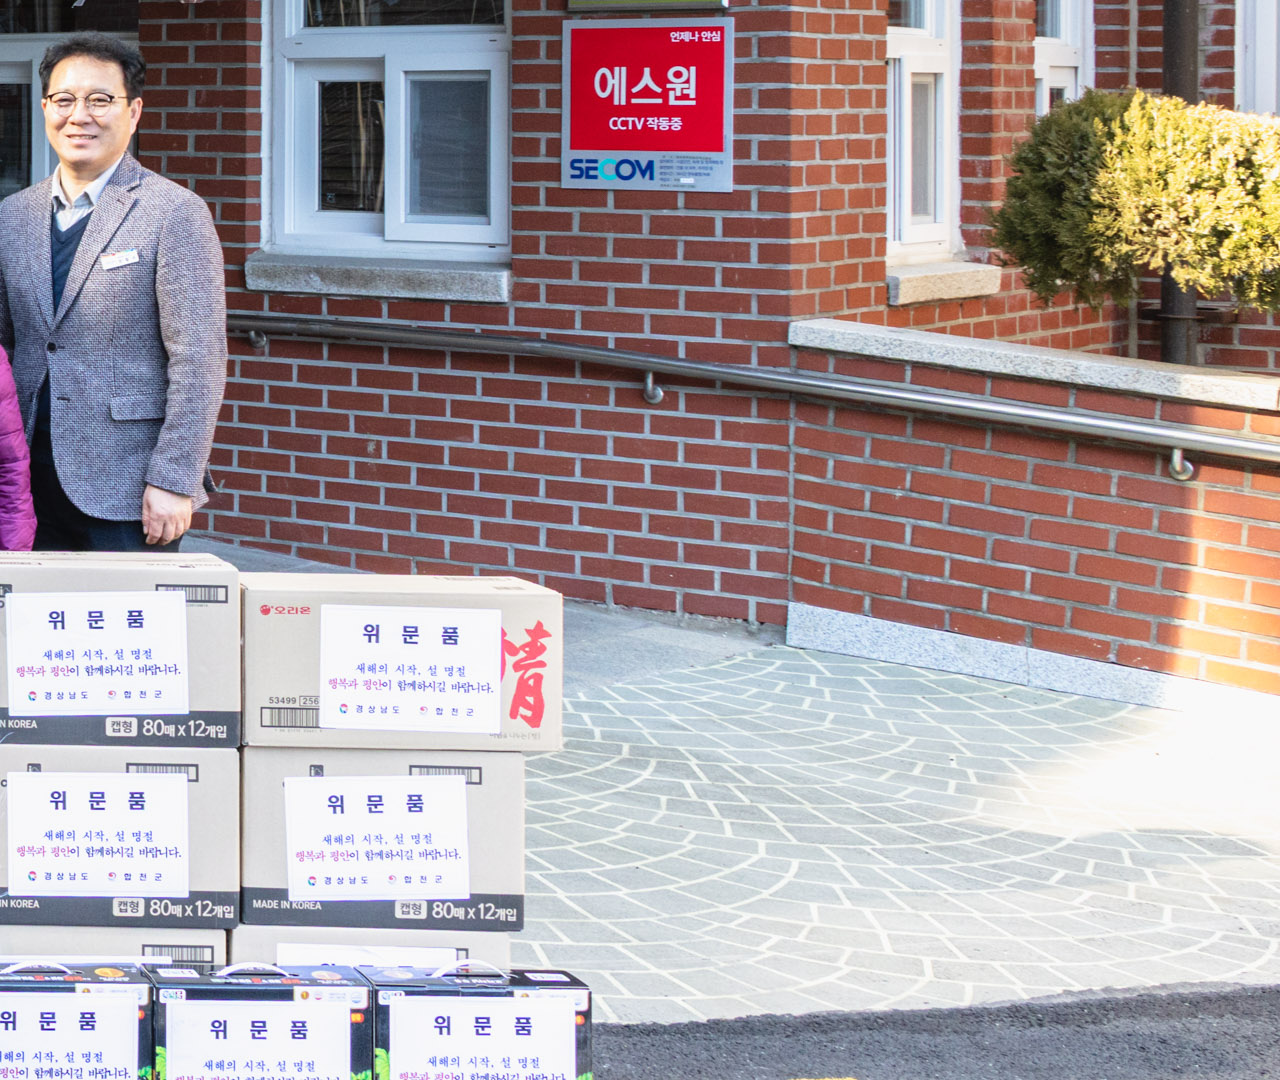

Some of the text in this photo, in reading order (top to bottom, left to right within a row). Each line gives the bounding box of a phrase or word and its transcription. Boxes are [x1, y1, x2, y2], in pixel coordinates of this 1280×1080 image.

[669, 30, 721, 42] 언제나 안심
[593, 66, 697, 106] 에스원
[608, 116, 683, 131] CCTV 작동중
[570, 158, 655, 181] SECOM
[274, 605, 311, 615] 오리온
[268, 696, 297, 706] 53499
[8, 719, 38, 729] KOREA
[110, 720, 133, 734] 캡형
[142, 719, 176, 738] 80매
[188, 720, 228, 739] 12개입
[44, 830, 153, 842] 새해의 시작, 설 명절
[16, 846, 181, 858] 행복과 평안이 함께하시길 바랍니다.
[9, 899, 39, 910] KOREA
[117, 900, 141, 915] 캡형
[149, 899, 184, 918] 80매
[195, 899, 235, 919] 12개입
[252, 899, 322, 911] MADE IN KOREA
[398, 902, 423, 917] 캡형
[431, 901, 466, 920] 80매
[477, 901, 518, 922] 12개입
